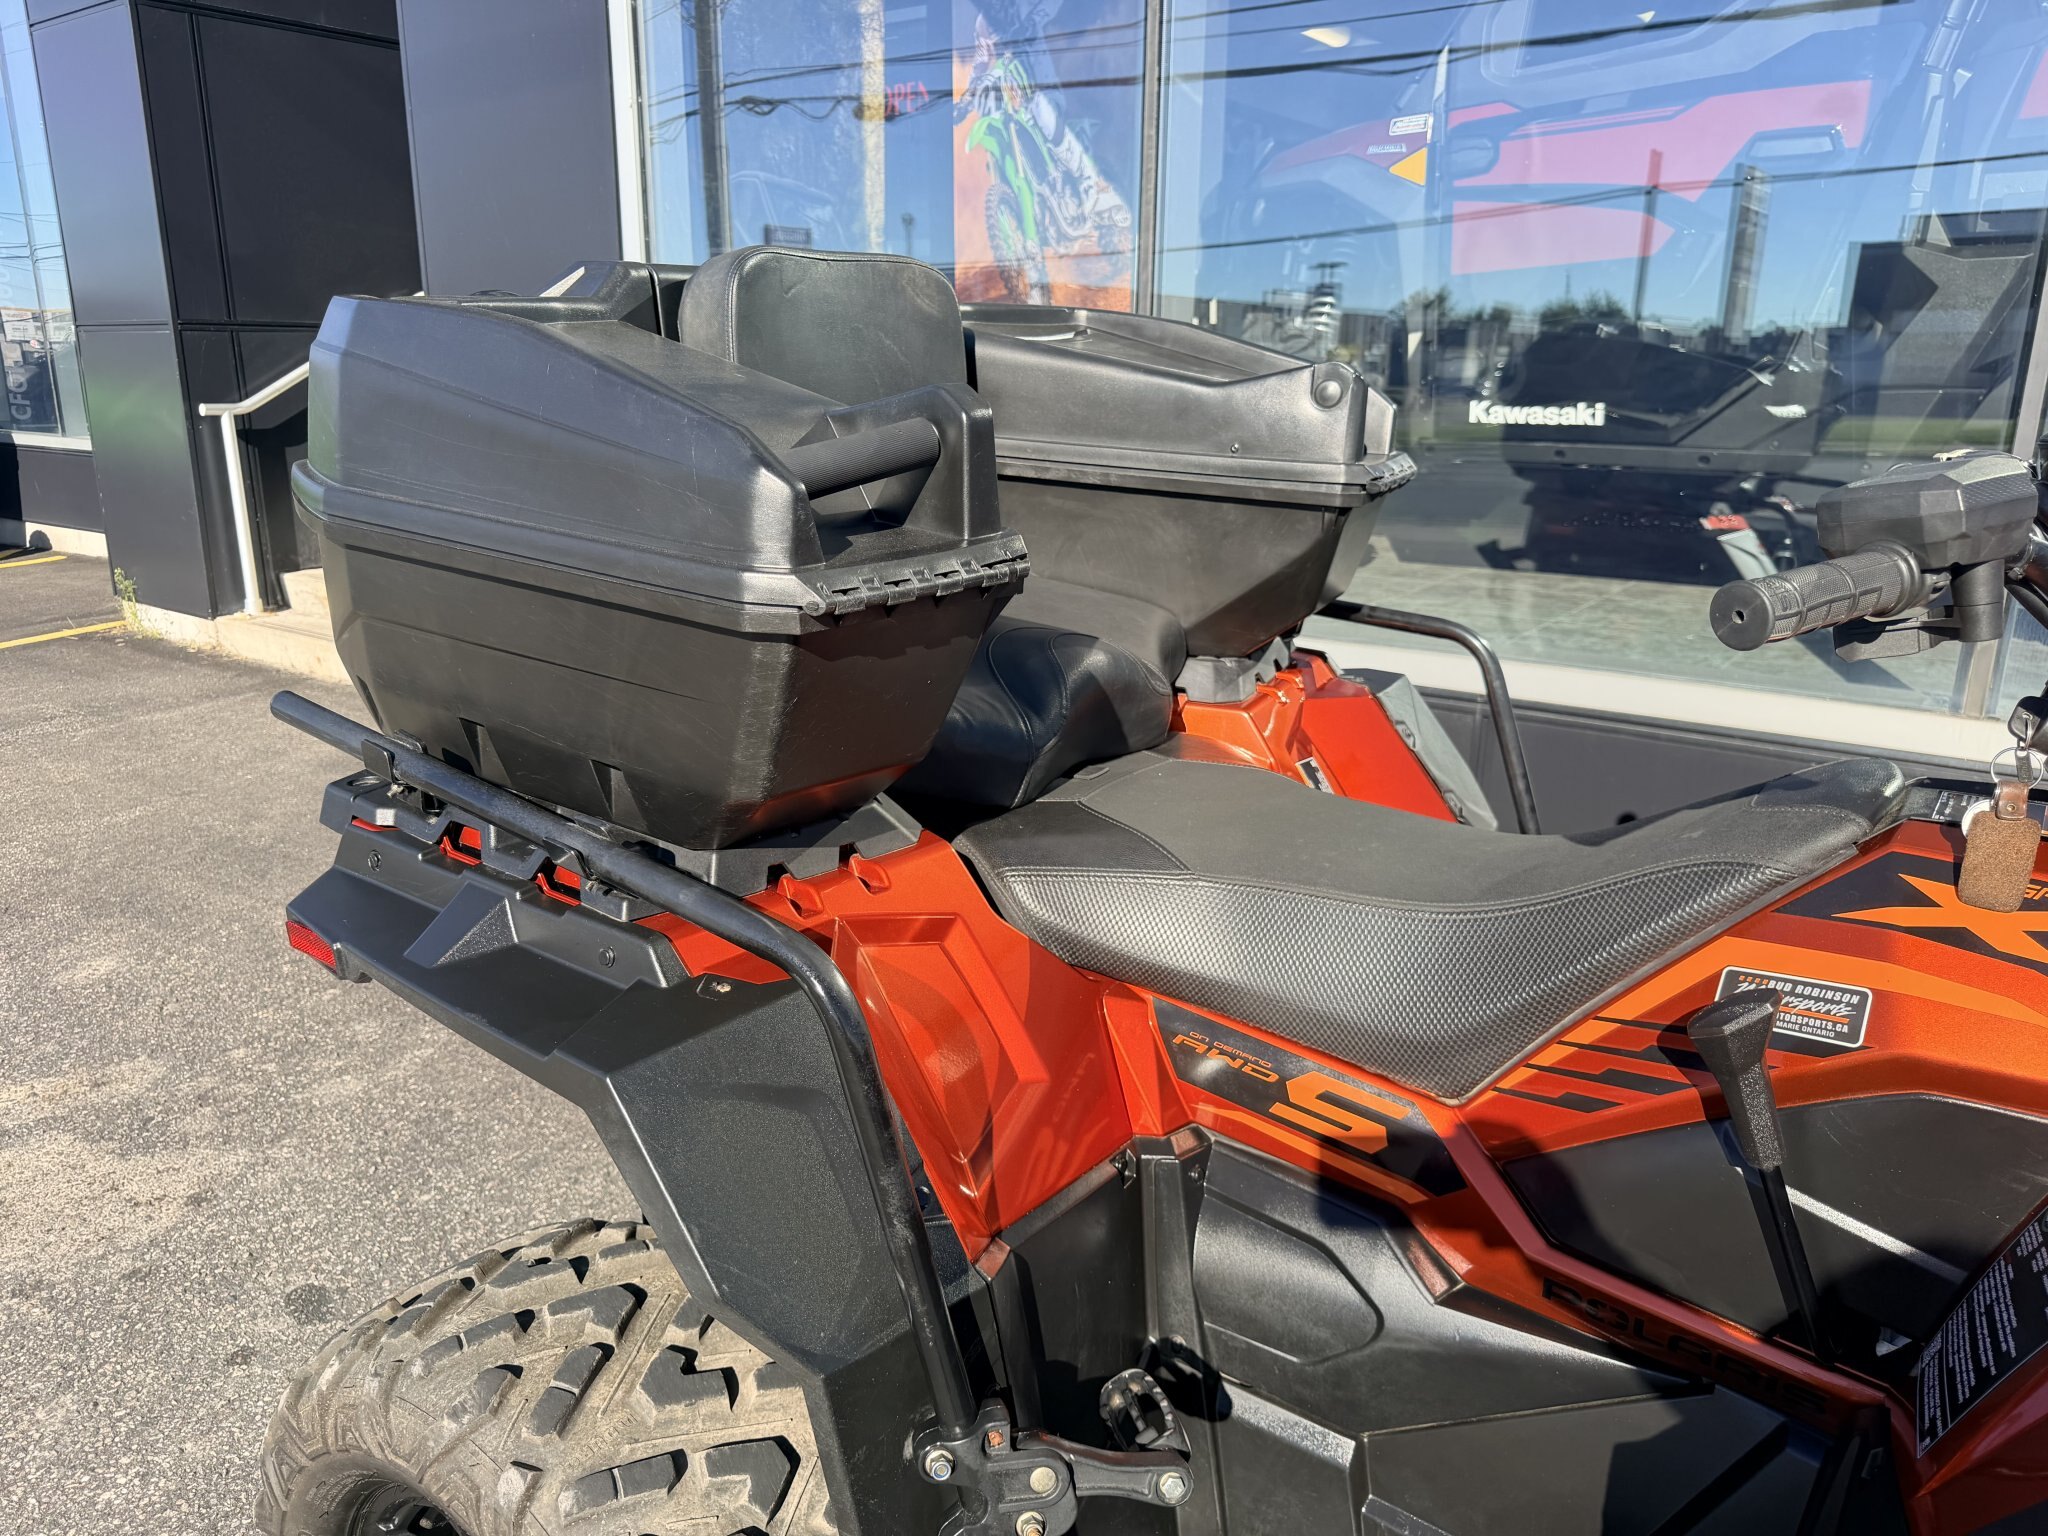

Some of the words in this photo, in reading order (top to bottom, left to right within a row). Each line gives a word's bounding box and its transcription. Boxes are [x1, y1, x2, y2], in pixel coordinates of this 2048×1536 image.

[1468, 400, 1606, 426] Kawasaki
[1767, 980, 1793, 992] BUD
[1795, 985, 1860, 1005] ROBINSON
[1776, 1021, 1800, 1031] MARIE
[1802, 1026, 1834, 1038] ONTARIO
[1172, 1034, 1280, 1083] AWD
[1541, 1277, 1830, 1414] POLARIS
